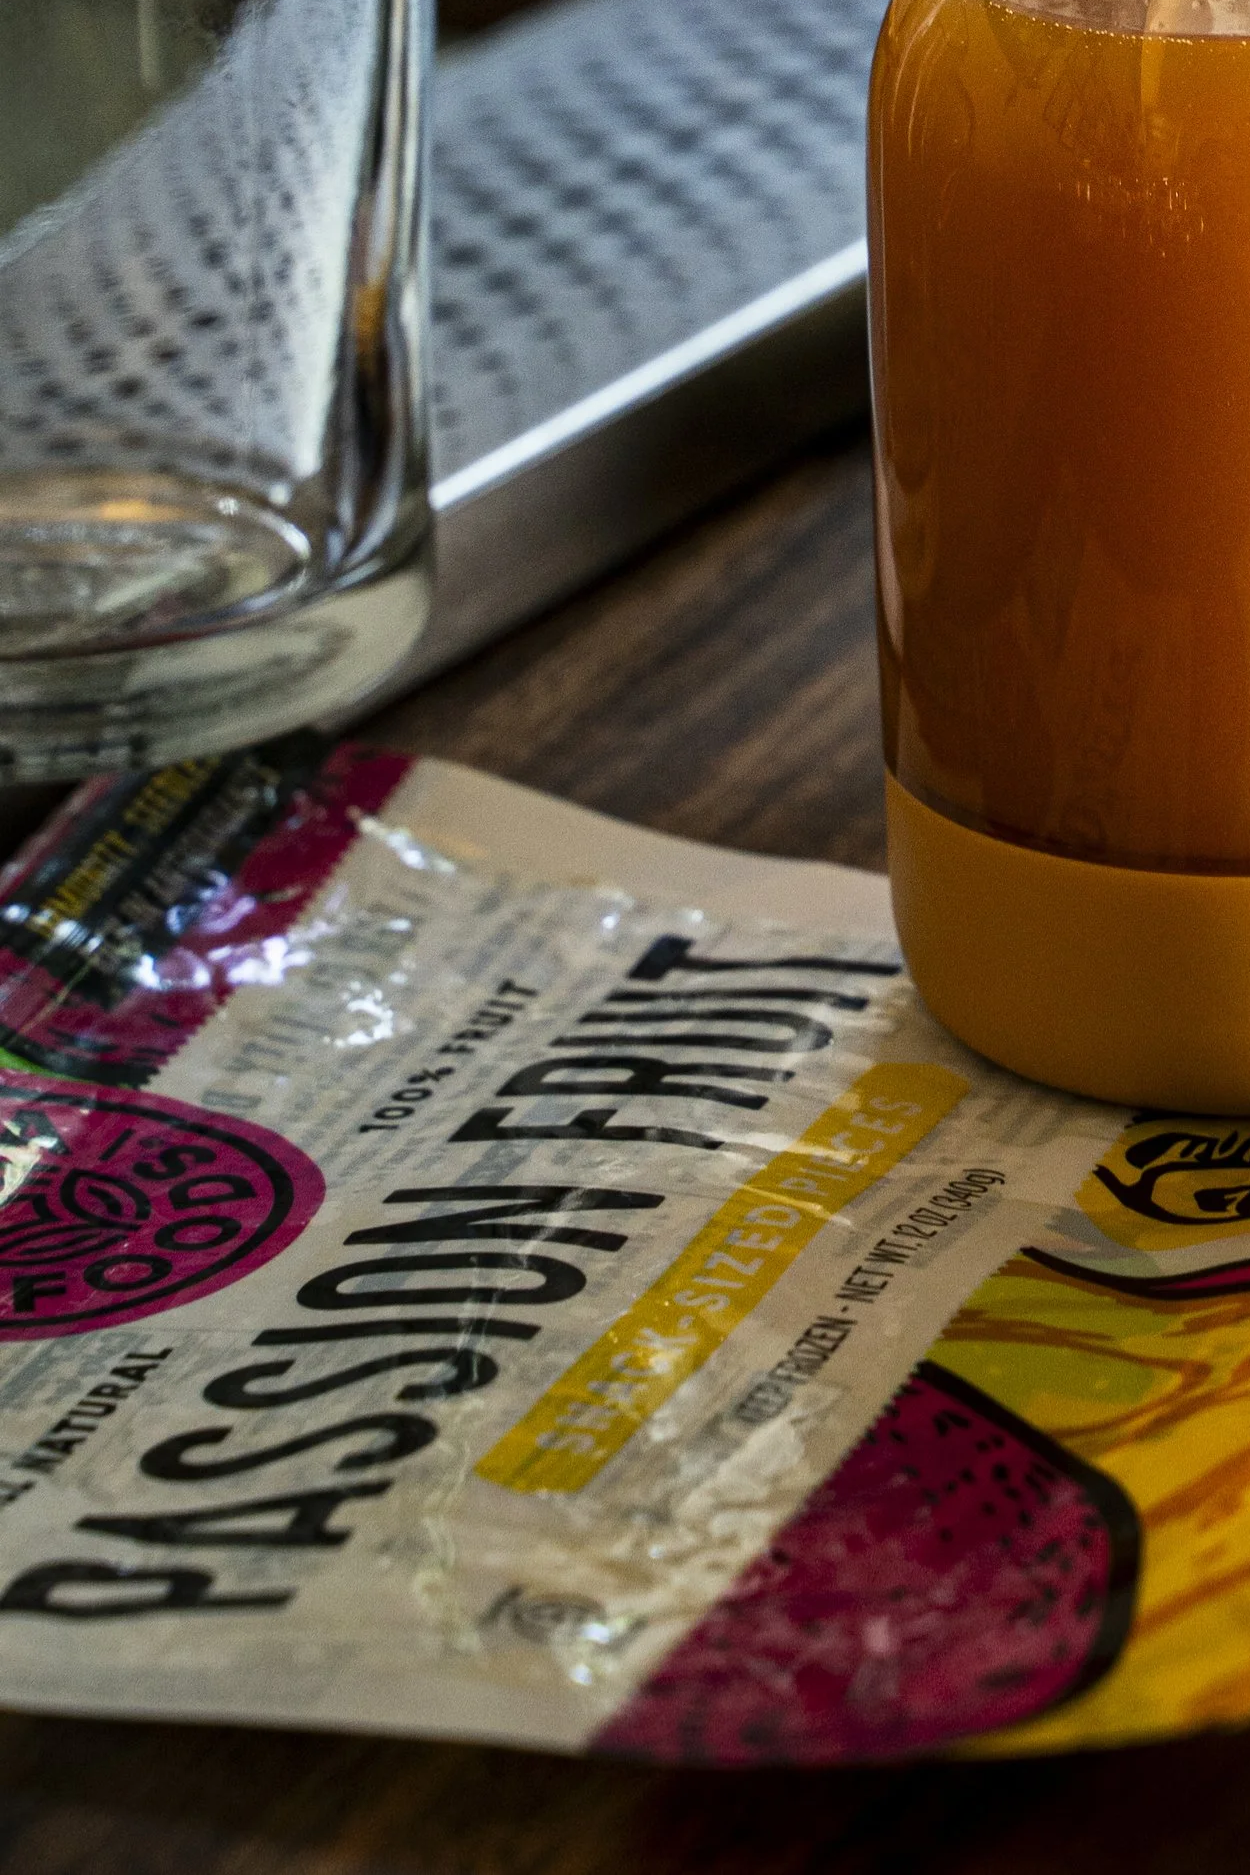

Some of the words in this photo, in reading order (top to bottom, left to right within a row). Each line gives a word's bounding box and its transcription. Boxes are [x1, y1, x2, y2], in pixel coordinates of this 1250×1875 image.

[358, 1066, 456, 1133] 100%
[435, 978, 540, 1056] FRUIT
[12, 1144, 258, 1313] FOODS
[892, 1223, 937, 1241] 12
[908, 1197, 958, 1228] OZ
[930, 1167, 1006, 1212] (340g)
[0, 1184, 666, 1618] PASSION
[447, 933, 902, 1150] FRUIT
[535, 1201, 803, 1457] SNACK-SIZED
[781, 1096, 923, 1196] PIECES
[835, 1265, 894, 1304] NET
[767, 1315, 858, 1385] FROZEN
[10, 1346, 174, 1476] NATURAL
